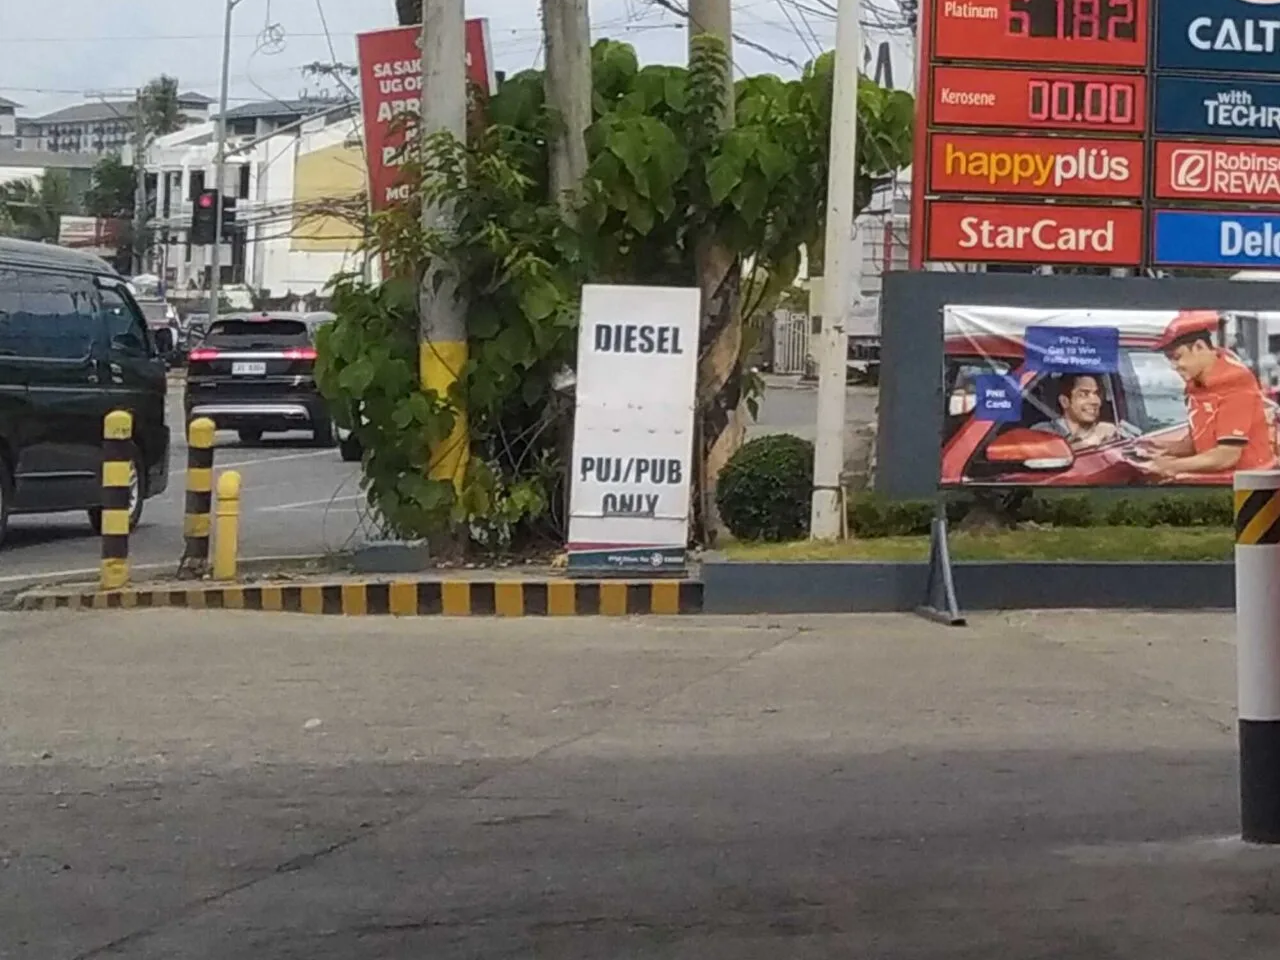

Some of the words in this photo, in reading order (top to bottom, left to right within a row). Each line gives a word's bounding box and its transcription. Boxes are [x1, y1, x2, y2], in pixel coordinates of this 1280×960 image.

[944, 1, 998, 19] Platinum
[941, 88, 996, 106] Kerosene
[1217, 90, 1252, 105] with
[945, 143, 1130, 187] happyplüs
[959, 217, 1114, 252] StarCard
[594, 323, 683, 355] DIESEL
[580, 457, 682, 484] PUJ/PUB
